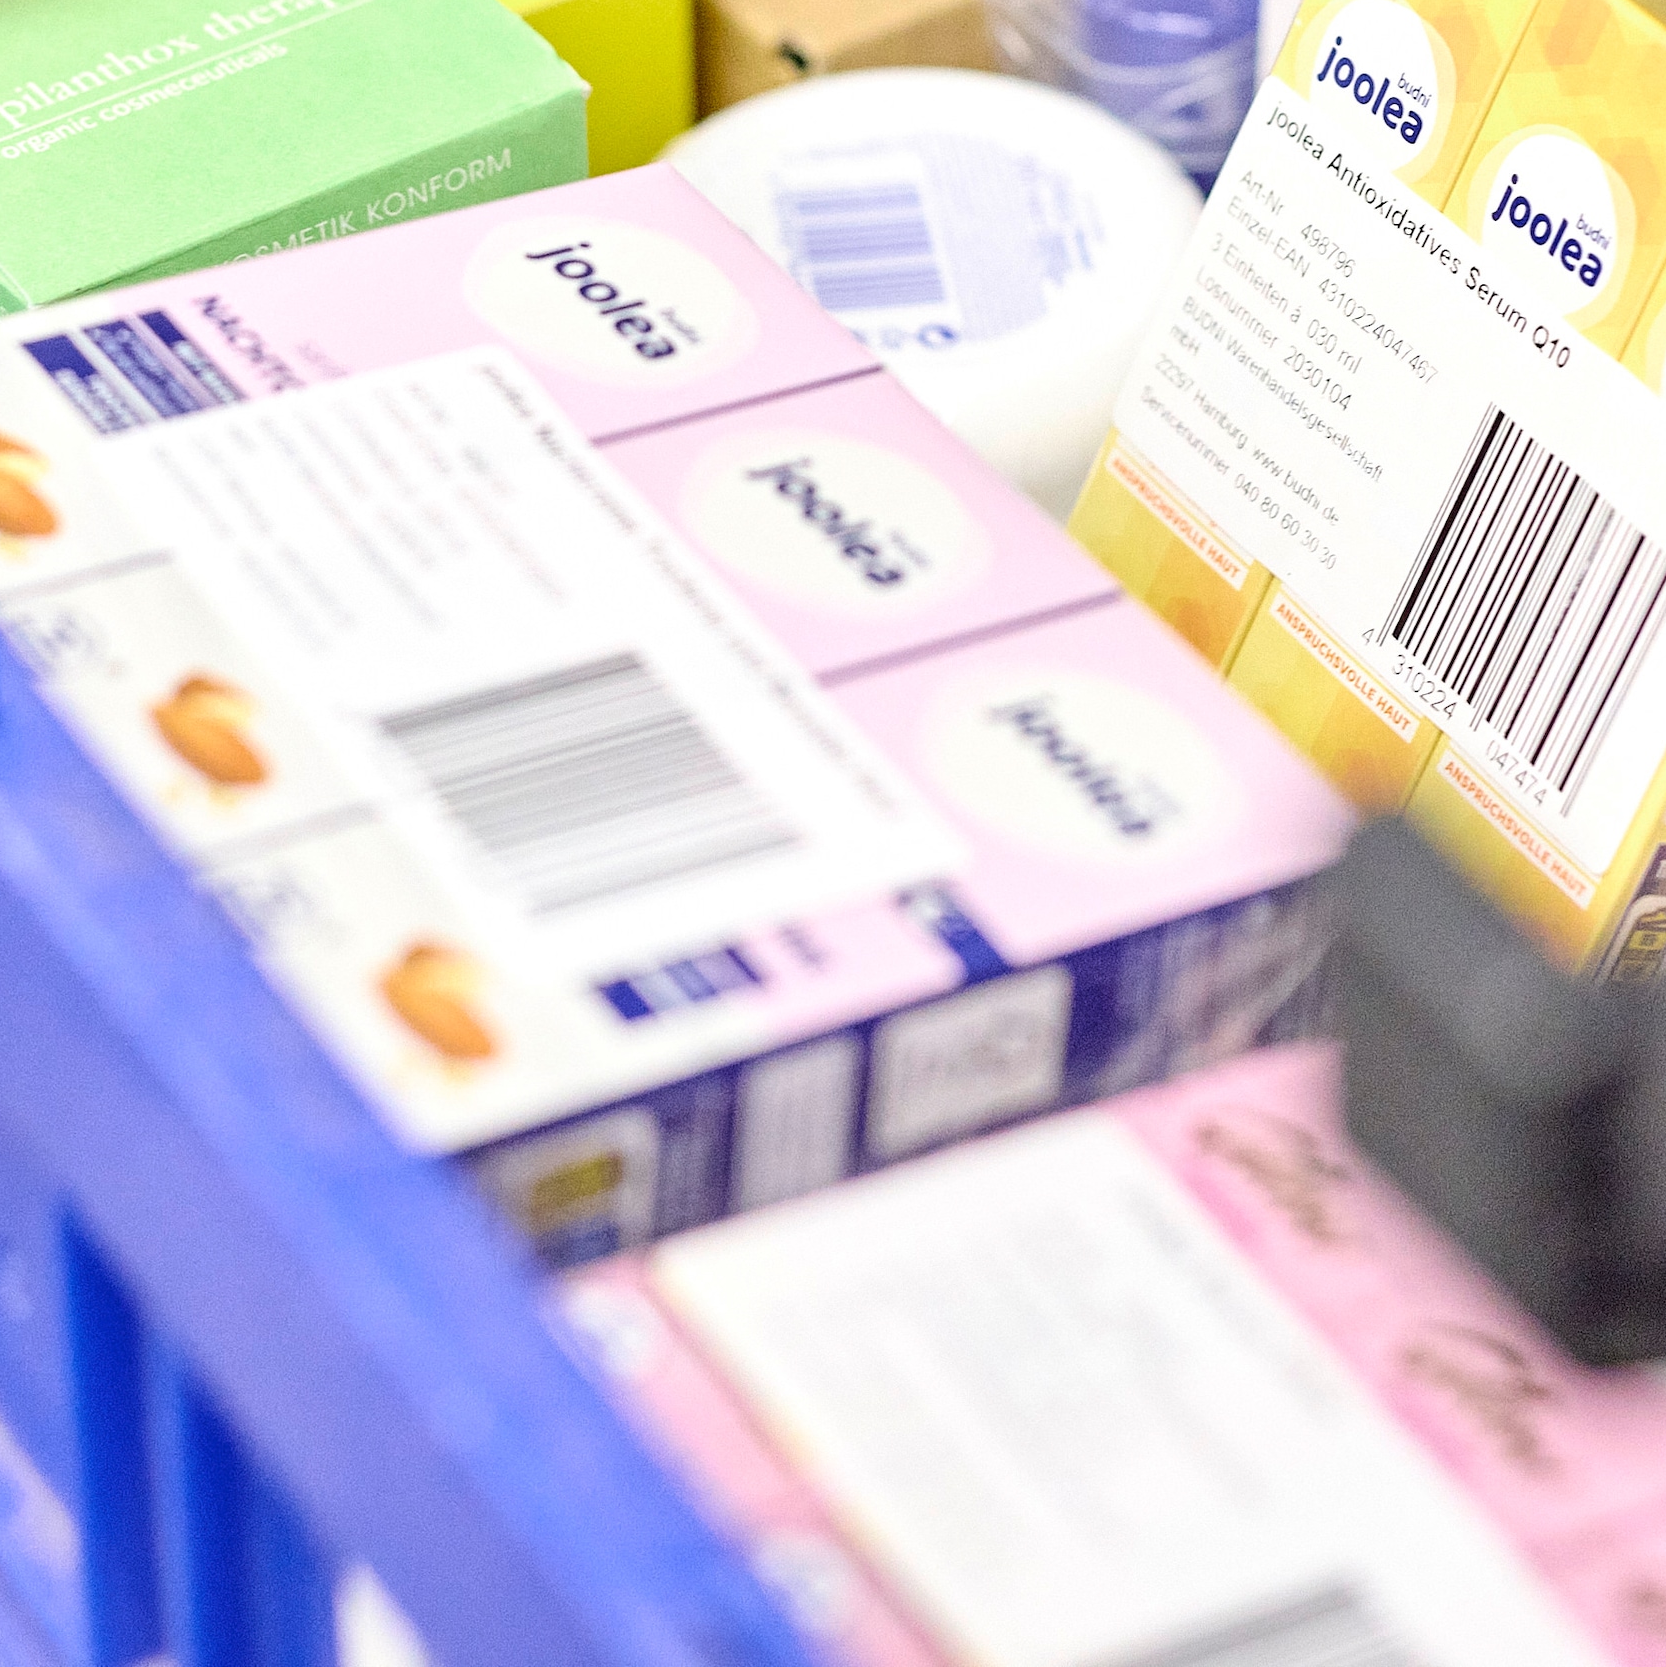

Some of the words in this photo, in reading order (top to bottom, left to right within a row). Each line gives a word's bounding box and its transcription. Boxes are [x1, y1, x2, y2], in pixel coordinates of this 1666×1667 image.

[0, 115, 98, 160] organic
[98, 41, 289, 123] cosmeceuticals
[1317, 36, 1423, 144] joolea
[1398, 73, 1432, 107] budni
[366, 148, 511, 224] KONFORM
[1267, 101, 1324, 159] joolea
[1327, 153, 1461, 275] Antioxidatives
[1465, 266, 1527, 333] Serum
[1532, 325, 1571, 368] Q10
[1492, 174, 1602, 287] joolea
[1576, 213, 1612, 250] budni
[525, 242, 675, 359] joolea
[1222, 243, 1289, 315] Einheiten
[1307, 318, 1338, 354] 030
[1338, 350, 1363, 375] ml
[1227, 195, 1311, 277] Einzel-EAN
[1318, 278, 1439, 384] 4310224047467
[1300, 224, 1356, 278] 498796
[1196, 264, 1279, 350] Losnummer
[1283, 345, 1353, 412] 2030104
[1227, 334, 1384, 484] Warenhandelsgesellschaft
[1207, 544, 1241, 579] HAUT
[1234, 473, 1260, 503] 040
[1260, 496, 1280, 519] 80
[1281, 513, 1301, 537] 60
[1300, 529, 1319, 554] 30
[1320, 546, 1337, 571] 30
[1276, 603, 1376, 701] ANSPRUCHSVOLLE
[1376, 697, 1412, 732] HAUT
[1361, 628, 1375, 646] 4
[1391, 654, 1458, 720] 310224
[1485, 739, 1548, 806] 047474
[1445, 761, 1550, 864] ANSPRUCHSVOLLE
[1549, 859, 1587, 897] HAUT
